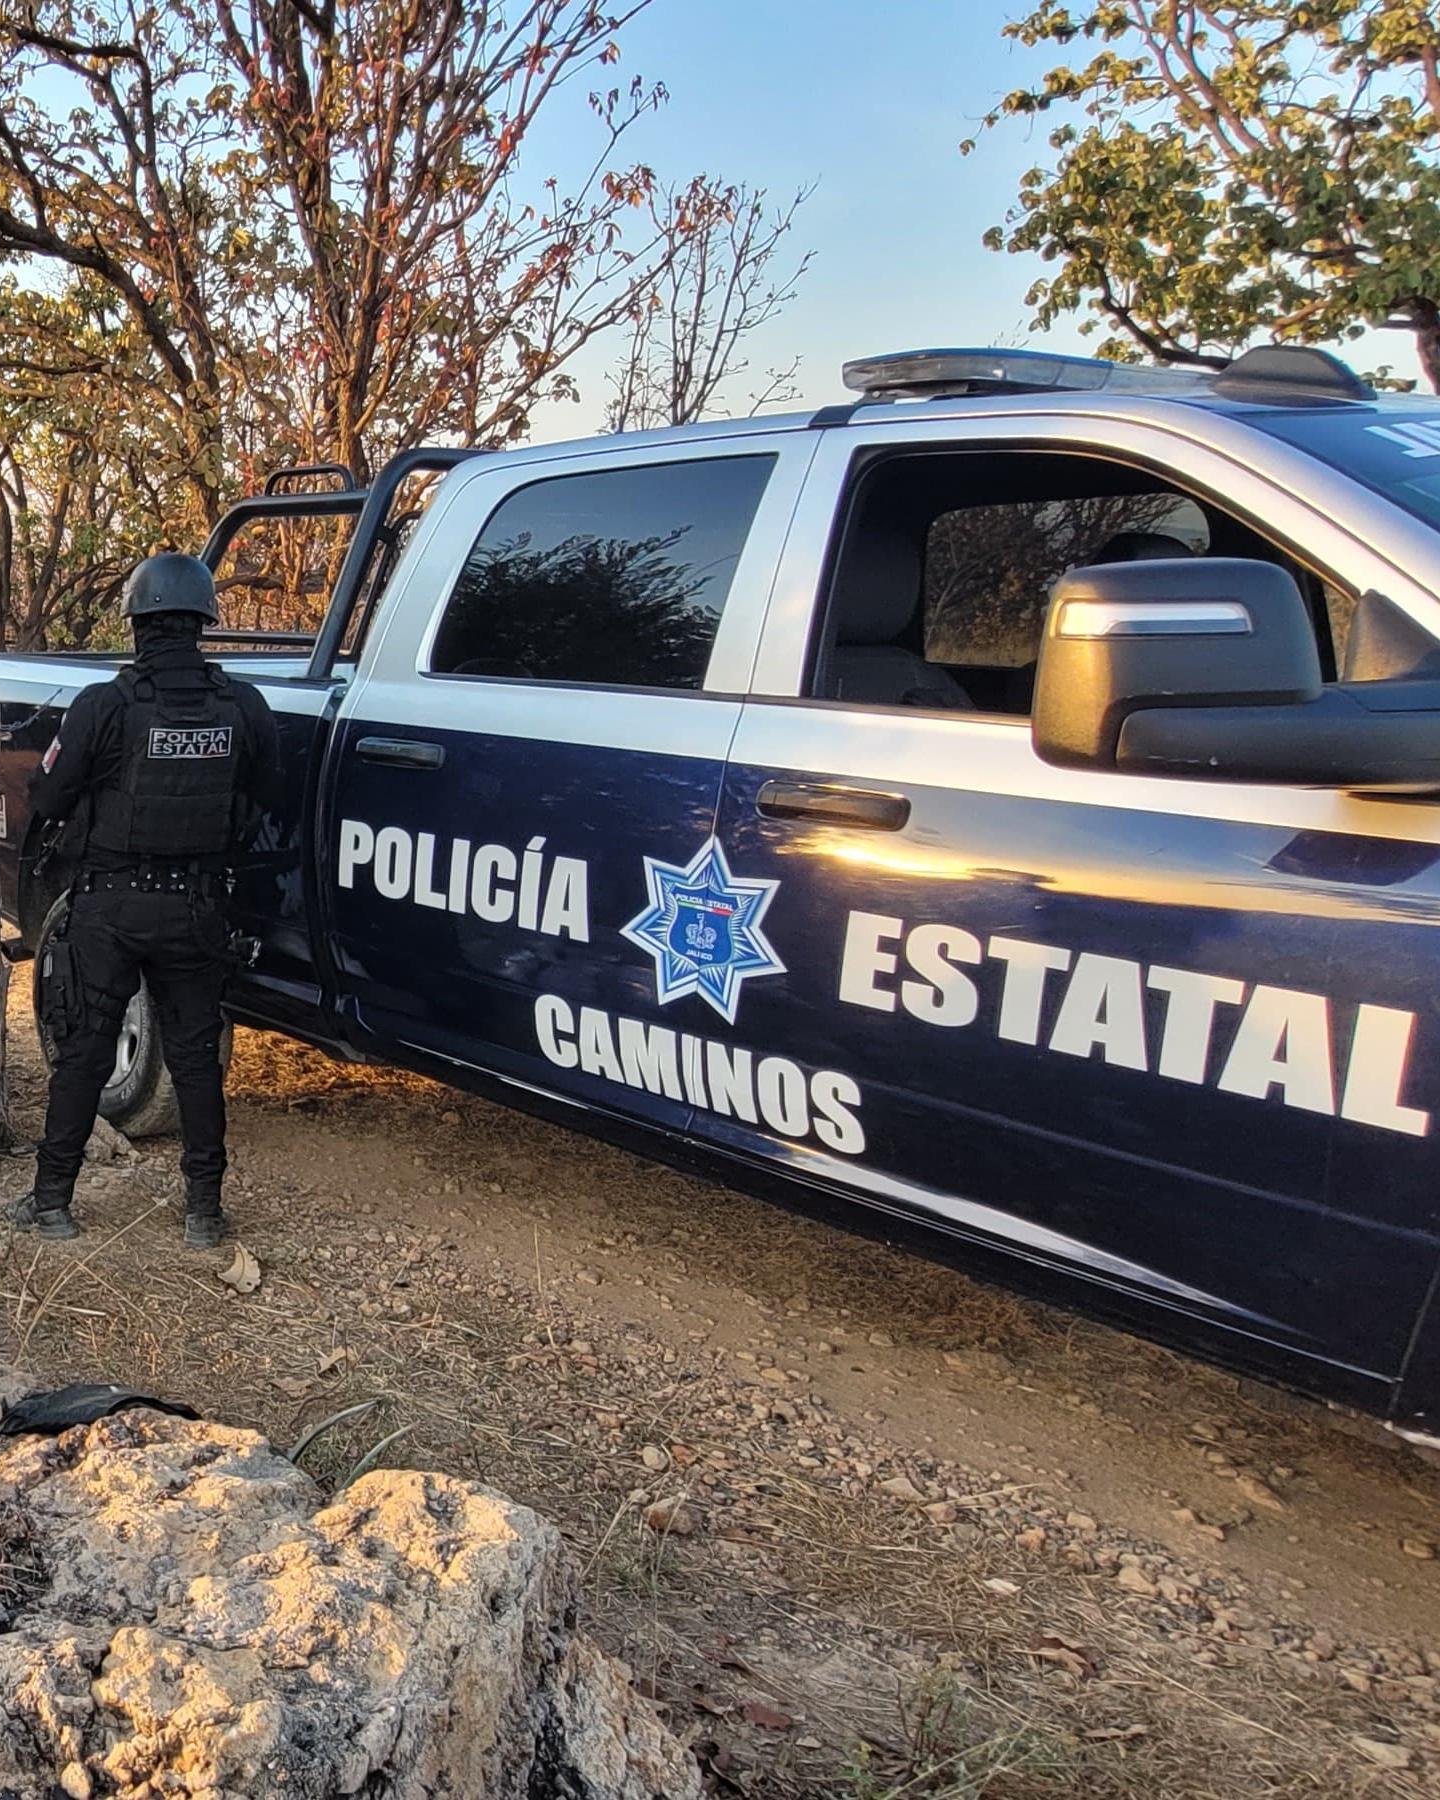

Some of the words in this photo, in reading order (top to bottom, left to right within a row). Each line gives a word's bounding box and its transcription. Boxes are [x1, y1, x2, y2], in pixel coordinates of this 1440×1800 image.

[152, 742, 227, 755] ESTATAL
[153, 731, 227, 743] POLICIA
[338, 818, 589, 943] POLICÍA
[839, 910, 1429, 1137] ESTATAL
[534, 994, 866, 1154] CAMINOS
